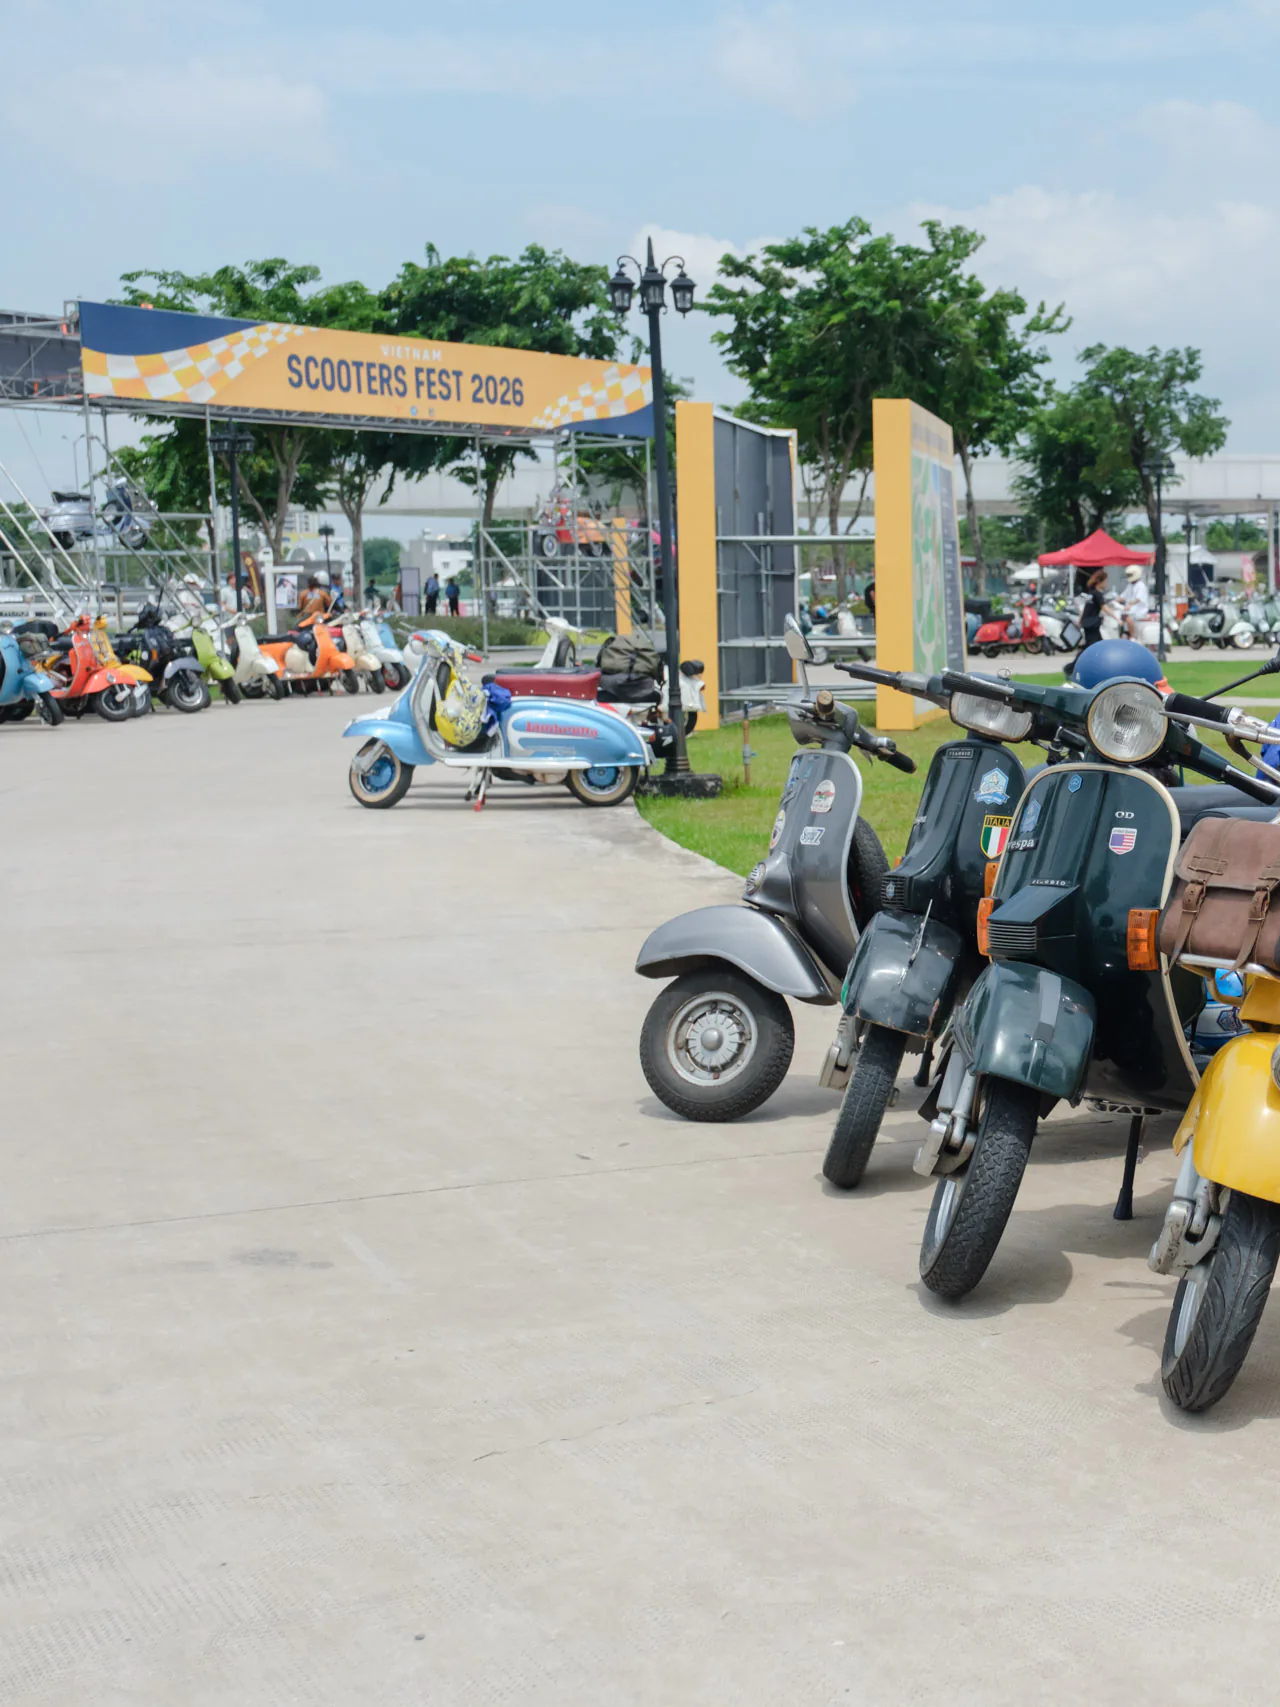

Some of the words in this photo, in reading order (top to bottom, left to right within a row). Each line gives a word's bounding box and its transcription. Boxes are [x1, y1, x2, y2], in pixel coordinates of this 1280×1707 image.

[381, 345, 441, 361] VIETNAM
[287, 354, 407, 398] SCOOTERS
[414, 366, 463, 402] FEST
[471, 374, 524, 407] 2026
[985, 818, 1010, 827] ITALIA
